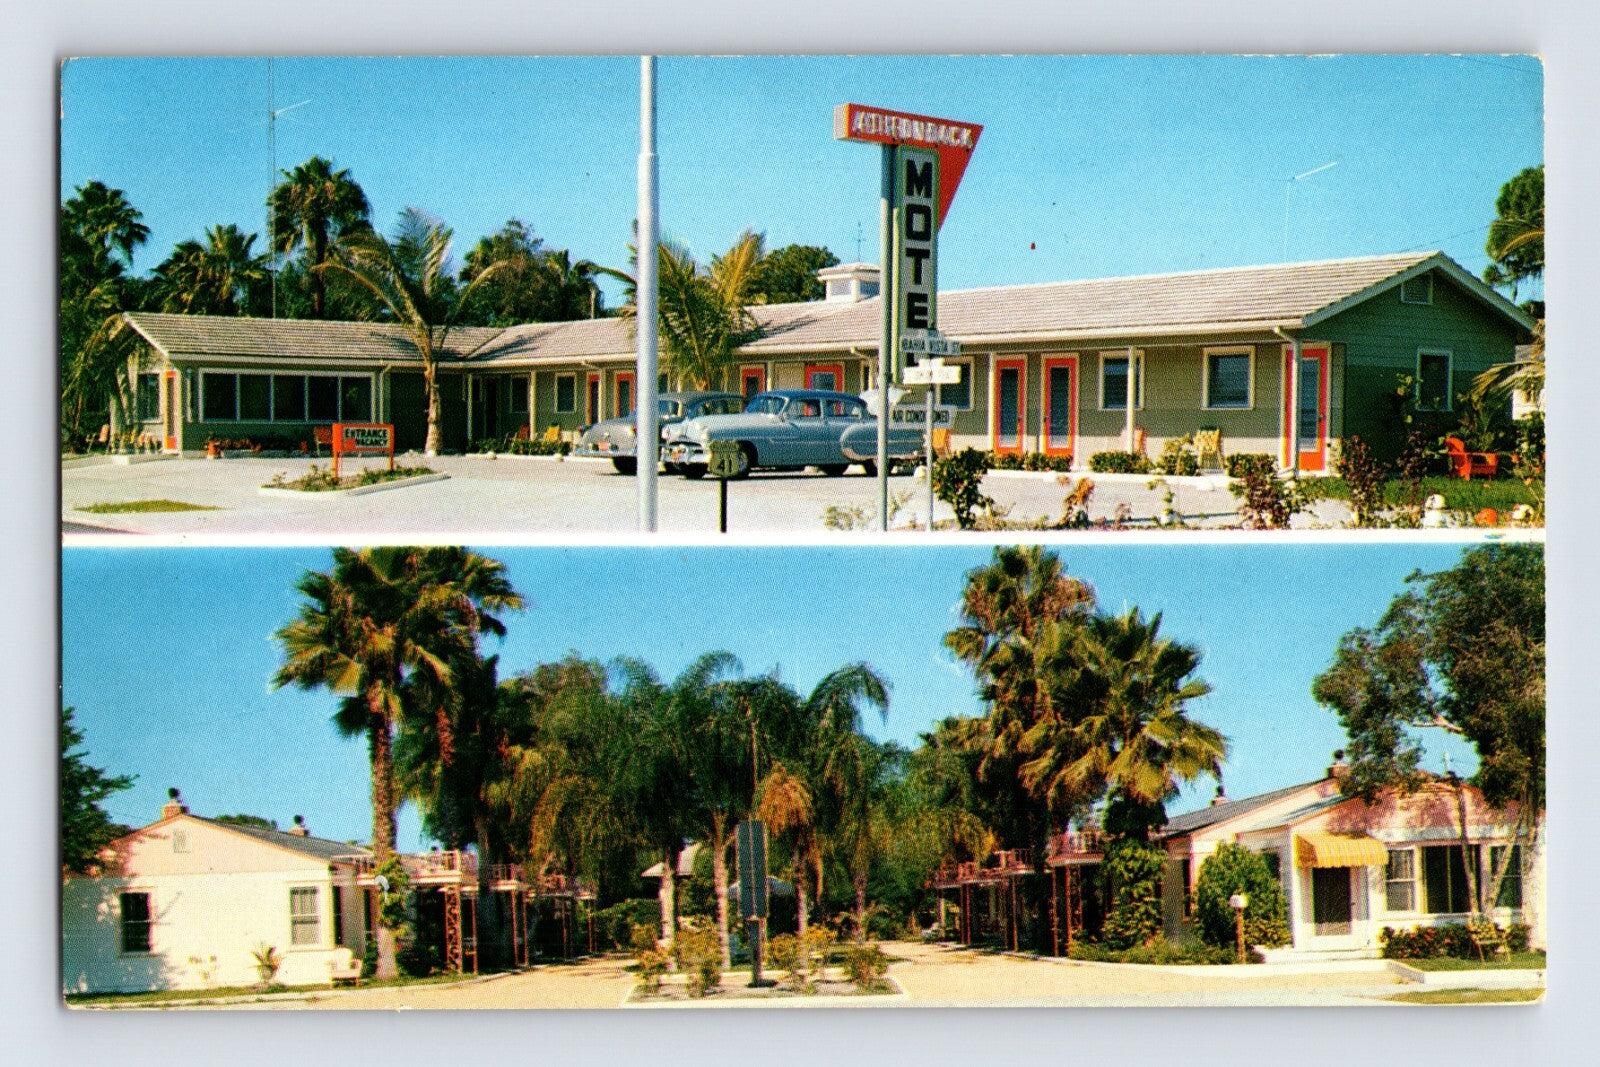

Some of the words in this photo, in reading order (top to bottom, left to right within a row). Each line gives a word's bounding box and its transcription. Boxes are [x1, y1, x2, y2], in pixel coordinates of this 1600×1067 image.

[344, 428, 388, 439] ENTRANCE
[355, 438, 388, 447] VACANCY
[716, 458, 733, 474] 41
